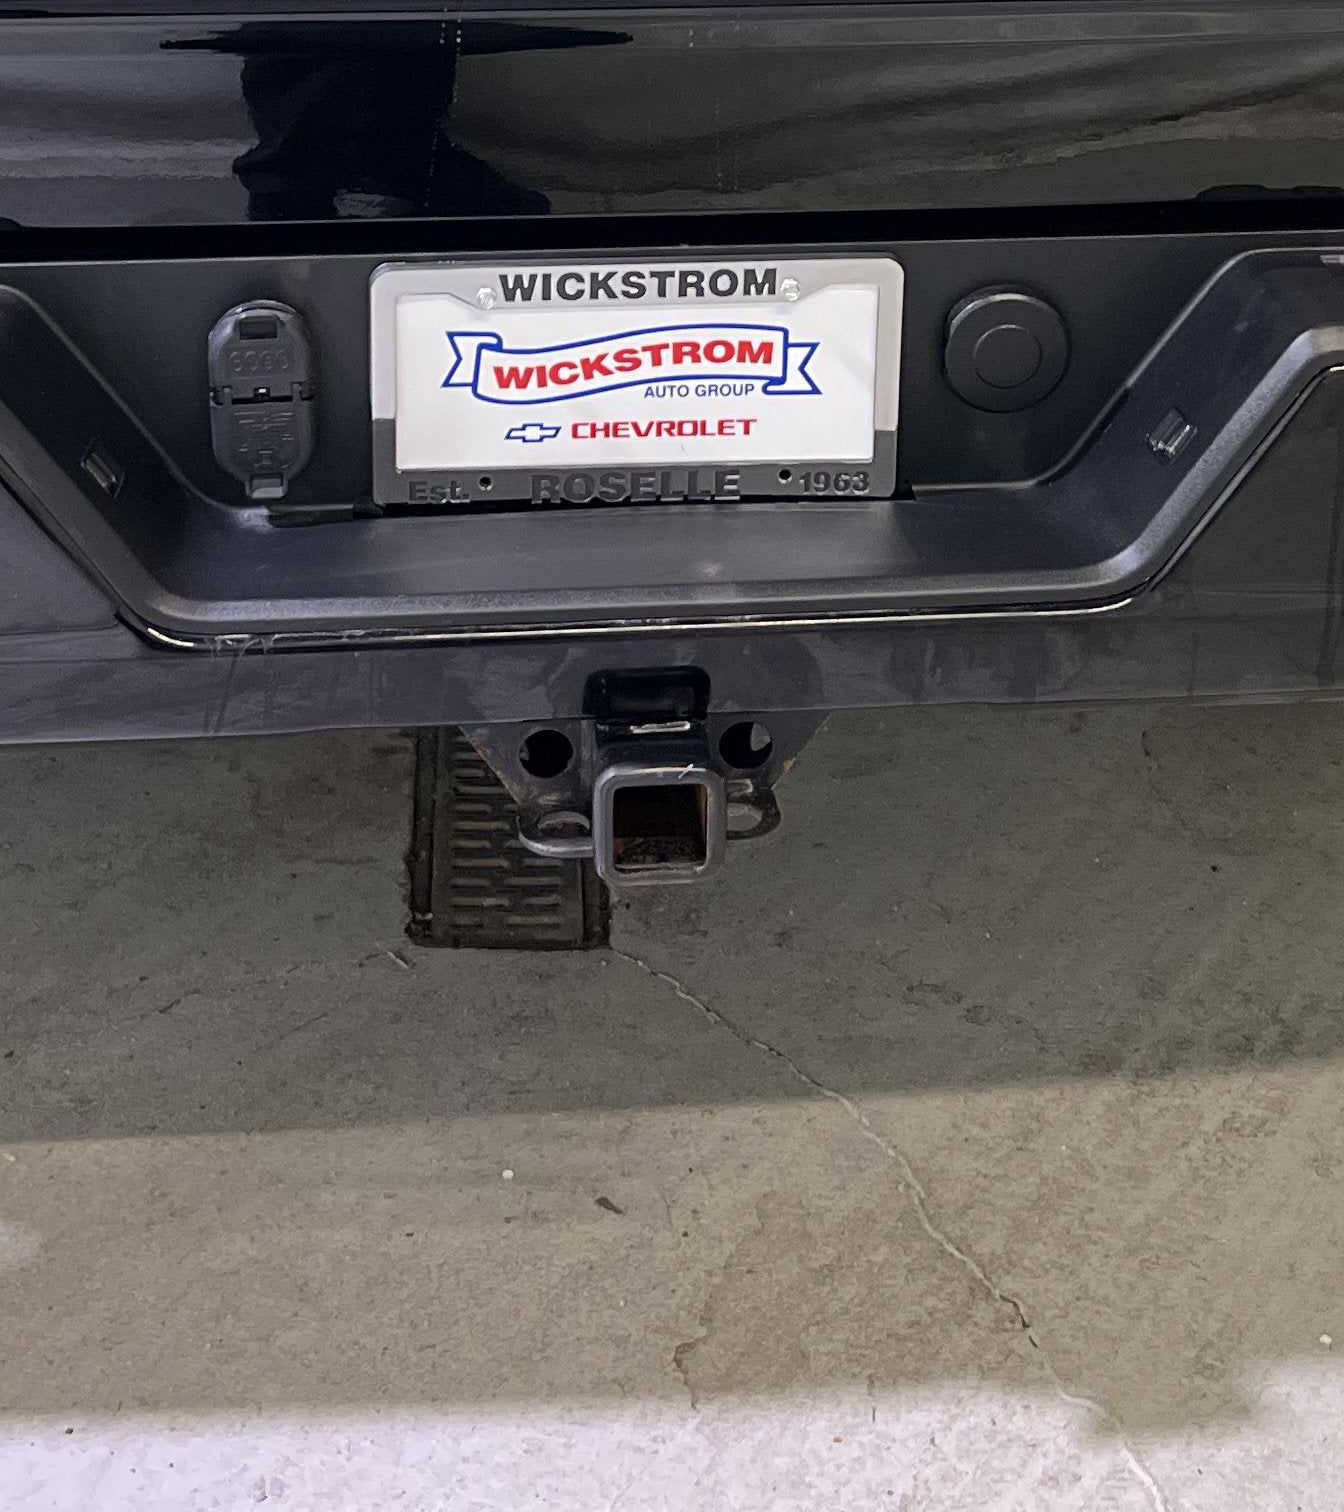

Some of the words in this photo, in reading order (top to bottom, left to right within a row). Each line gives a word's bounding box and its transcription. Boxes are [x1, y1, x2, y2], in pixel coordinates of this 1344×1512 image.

[498, 268, 778, 302] WICKSTROM
[493, 340, 774, 390] WICKSTROM
[643, 385, 692, 399] AUTO
[694, 383, 755, 398] GROUP
[571, 419, 758, 439] CHEVROLET
[531, 469, 741, 504] ROSELLE
[798, 470, 870, 496] 1963
